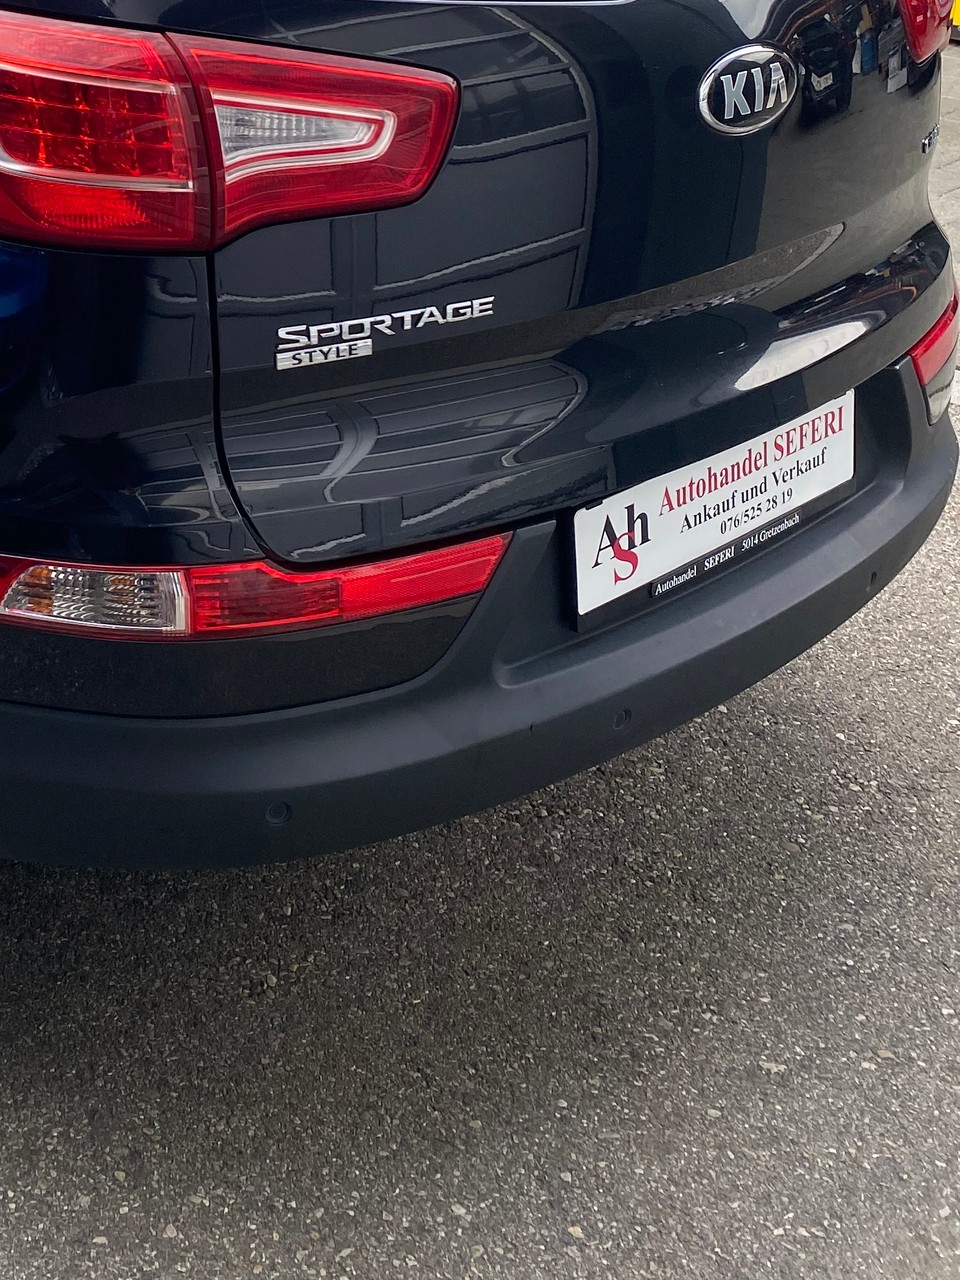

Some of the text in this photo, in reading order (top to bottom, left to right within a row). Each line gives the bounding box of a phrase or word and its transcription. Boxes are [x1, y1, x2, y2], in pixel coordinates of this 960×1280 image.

[720, 62, 788, 120] KIA
[276, 296, 495, 350] SPORTAGE
[292, 343, 359, 365] STYLE
[659, 406, 844, 516] Autohandel SEFERI
[680, 447, 827, 533] Ankauf und Verkauf
[720, 488, 793, 534] 076/525 28 19
[655, 514, 800, 596] Autohandel SEFERI 5014 Gretzenbach
